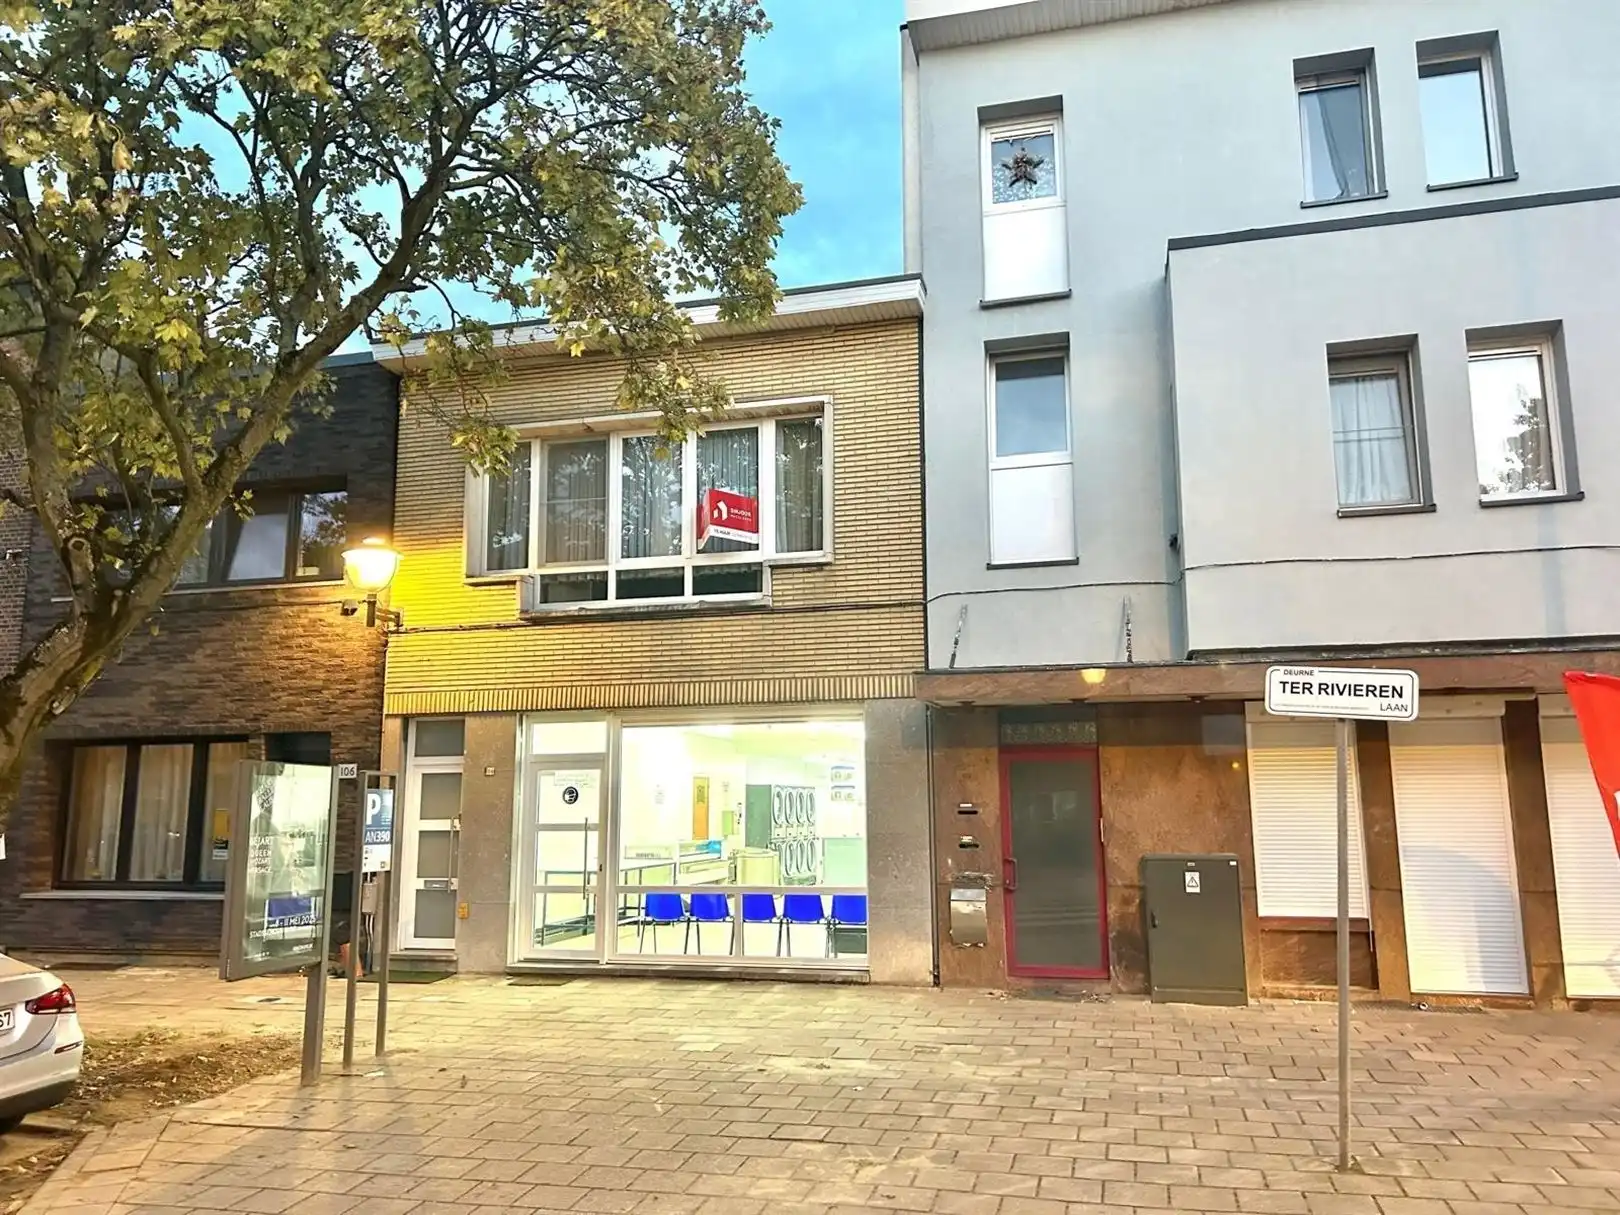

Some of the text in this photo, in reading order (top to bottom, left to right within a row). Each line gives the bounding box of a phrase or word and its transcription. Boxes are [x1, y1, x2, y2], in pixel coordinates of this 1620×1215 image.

[1283, 668, 1315, 677] DEURNE
[1279, 681, 1404, 699] TER RIVIEREN
[1380, 703, 1409, 713] LAAN
[340, 766, 355, 777] 106
[366, 793, 381, 826] P
[365, 829, 391, 843] AN390
